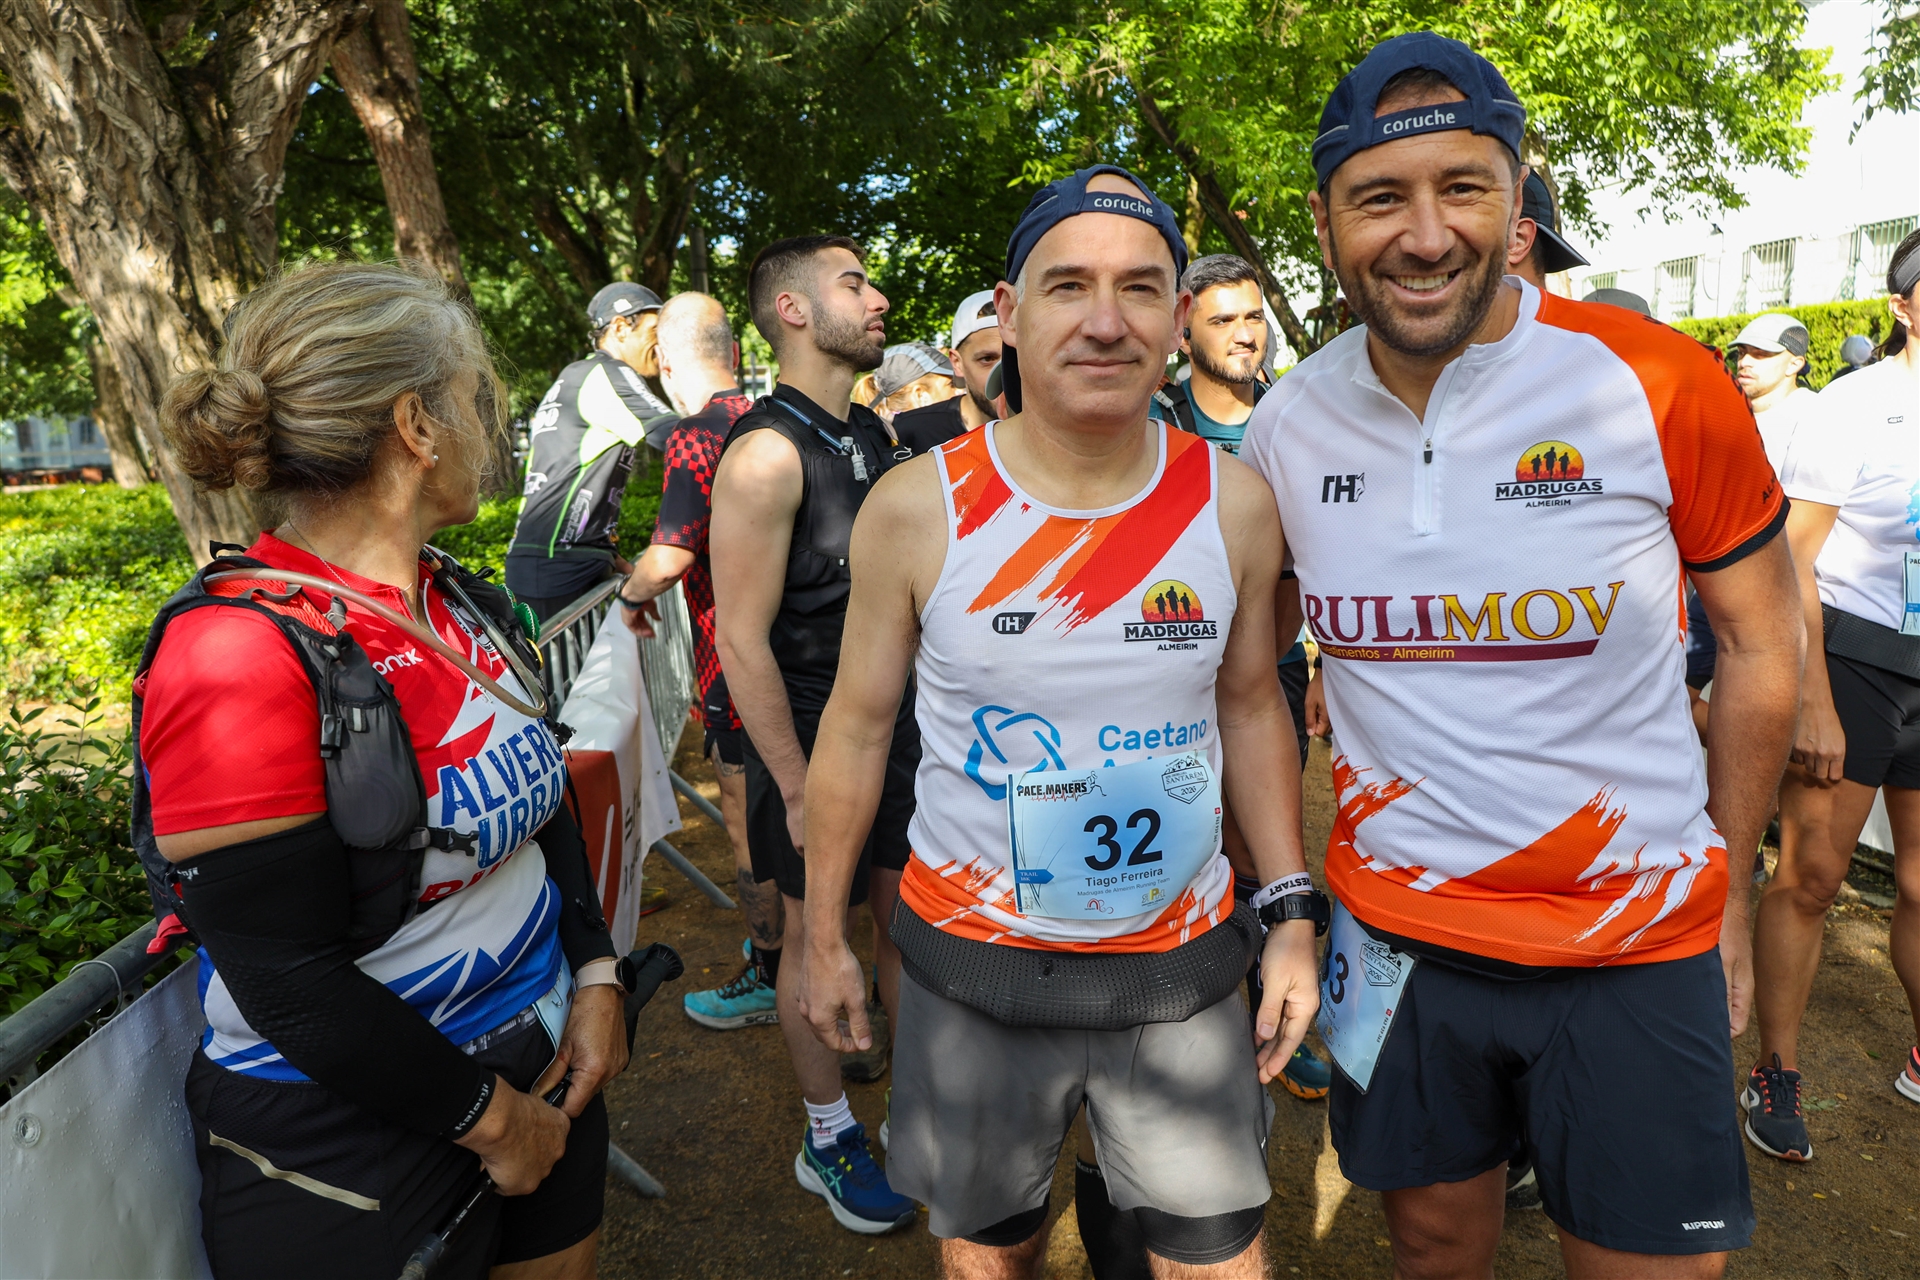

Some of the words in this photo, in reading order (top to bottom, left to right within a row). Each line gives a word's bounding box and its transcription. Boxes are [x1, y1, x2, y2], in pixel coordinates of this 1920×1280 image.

[1382, 109, 1456, 134] coruche
[1093, 198, 1154, 218] coruche
[1495, 480, 1603, 498] MADRUGAS
[1525, 499, 1572, 509] ALMEIRIM
[1304, 580, 1625, 642] RULIMOV
[1124, 623, 1218, 639] MADRUGAS
[1157, 642, 1198, 651] ALMEIRIM
[1392, 647, 1455, 659] Almeirim
[1098, 719, 1207, 752] Caetano
[1083, 808, 1163, 872] 32
[1085, 876, 1118, 888] Tiago
[1121, 868, 1163, 882] Ferreira
[1136, 881, 1156, 889] Running
[1682, 1220, 1726, 1230] KIPRUN
